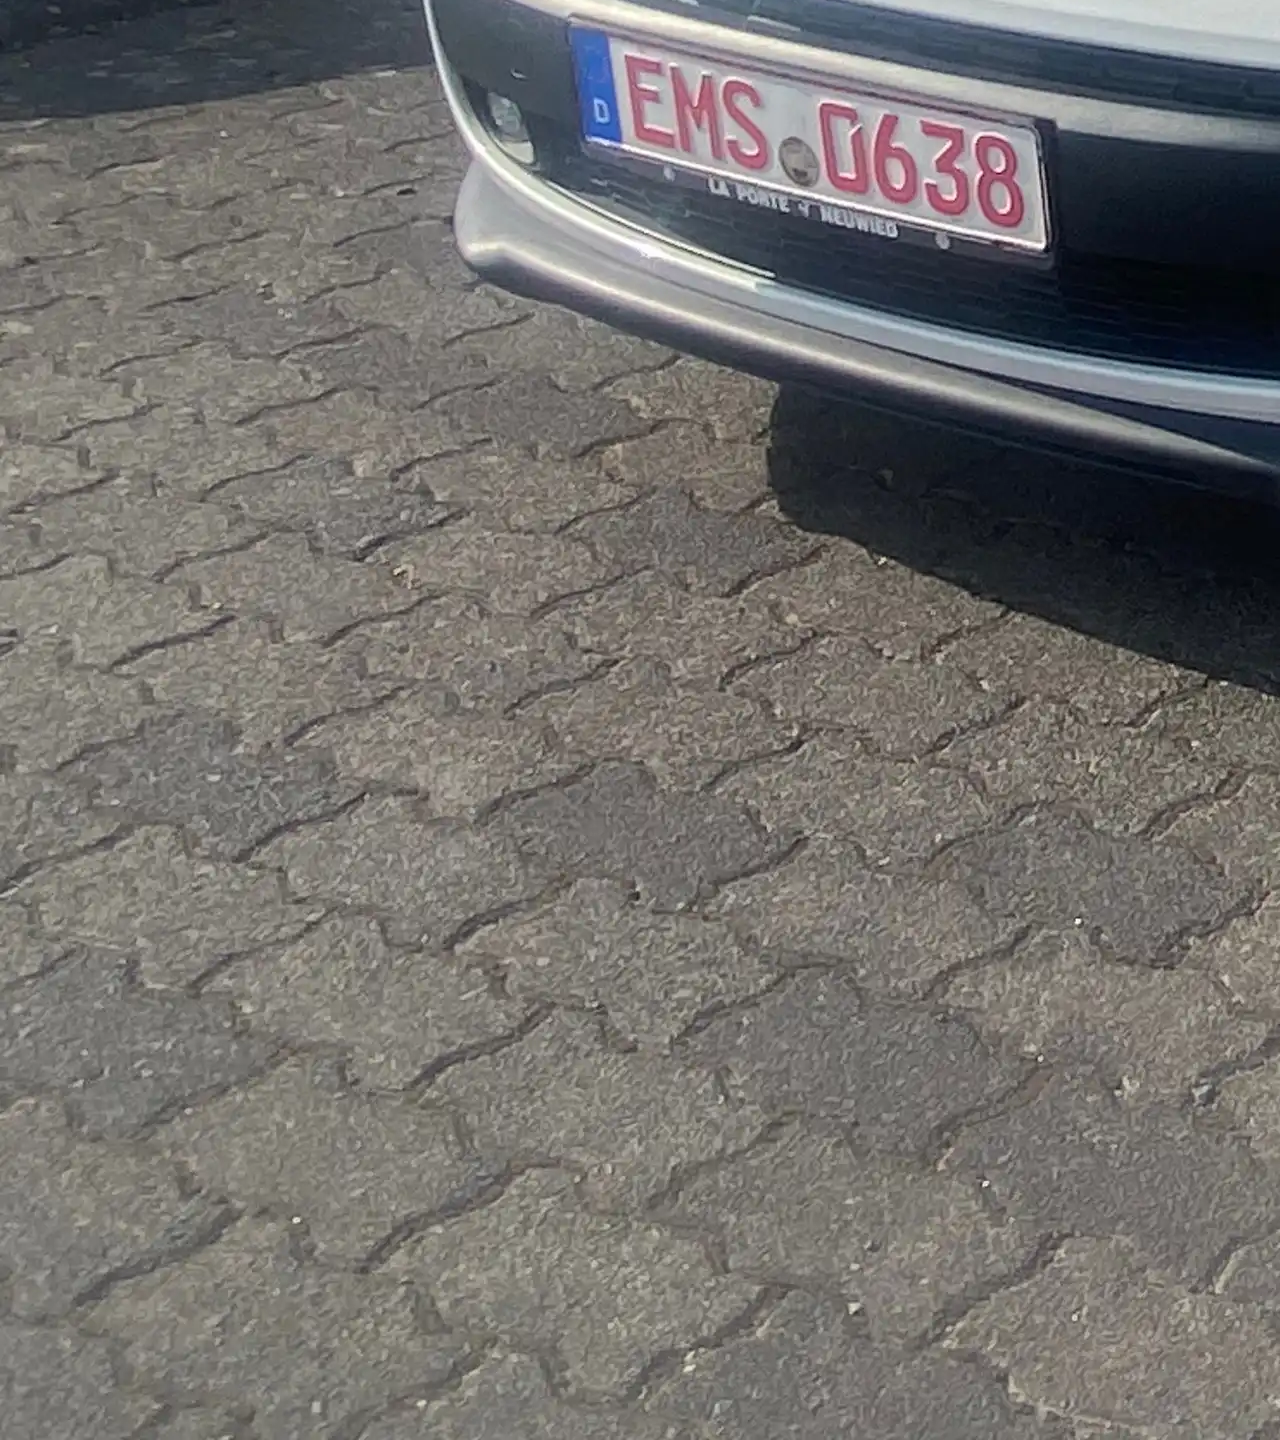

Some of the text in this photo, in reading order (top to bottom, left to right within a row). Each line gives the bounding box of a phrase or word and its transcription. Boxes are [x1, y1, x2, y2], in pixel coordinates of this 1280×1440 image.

[593, 97, 610, 124] D
[624, 53, 1025, 229] EMS 0638
